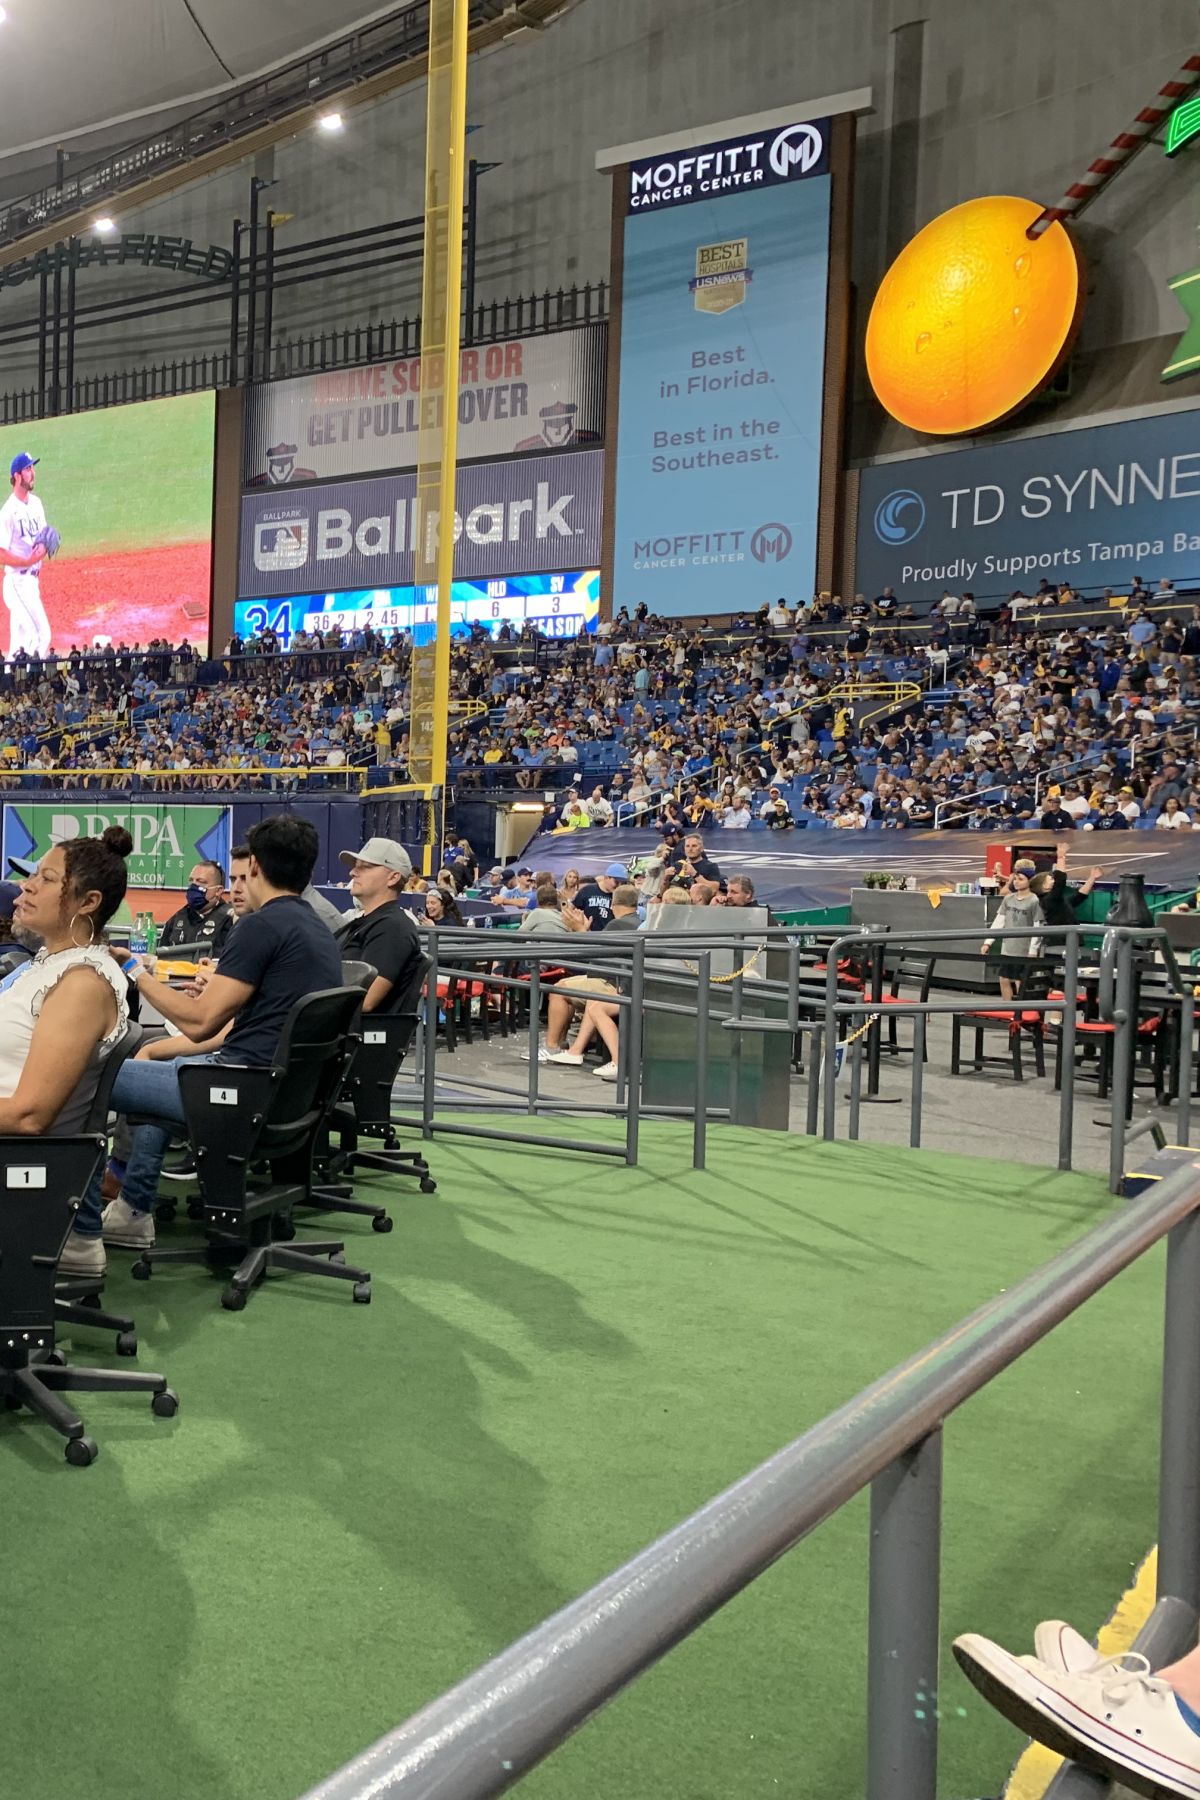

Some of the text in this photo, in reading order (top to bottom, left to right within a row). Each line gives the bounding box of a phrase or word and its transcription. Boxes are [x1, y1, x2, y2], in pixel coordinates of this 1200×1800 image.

[631, 141, 765, 194] MOFFITT
[630, 169, 763, 207] CANCER CENTER
[700, 242, 744, 264] BEST
[699, 258, 743, 275] HOSPITALS
[392, 350, 478, 395] SOBR
[485, 342, 523, 380] OR
[691, 346, 745, 369] Best
[660, 368, 775, 399] in Florida.
[307, 410, 355, 447] GET
[458, 382, 528, 424] OVER
[653, 419, 780, 449] Best in the
[651, 443, 780, 473] Southeast.
[263, 509, 301, 521] BALLPARK
[941, 484, 1006, 528] TD
[317, 482, 574, 564] Ballpark
[634, 531, 744, 558] MOFFITT
[633, 553, 744, 570] CANCER CENTER
[902, 558, 978, 584] Proudly
[984, 547, 1081, 575] Supports
[1088, 539, 1164, 561] Tampa
[487, 576, 564, 597] HLD SV
[492, 602, 500, 617] 6
[552, 597, 560, 613] 3
[367, 609, 398, 627] 2.45
[84, 814, 185, 857] RPA
[128, 860, 184, 868] IATES
[128, 872, 165, 883] ERS.COM
[220, 1090, 227, 1101] 4
[23, 1170, 30, 1185] 1
